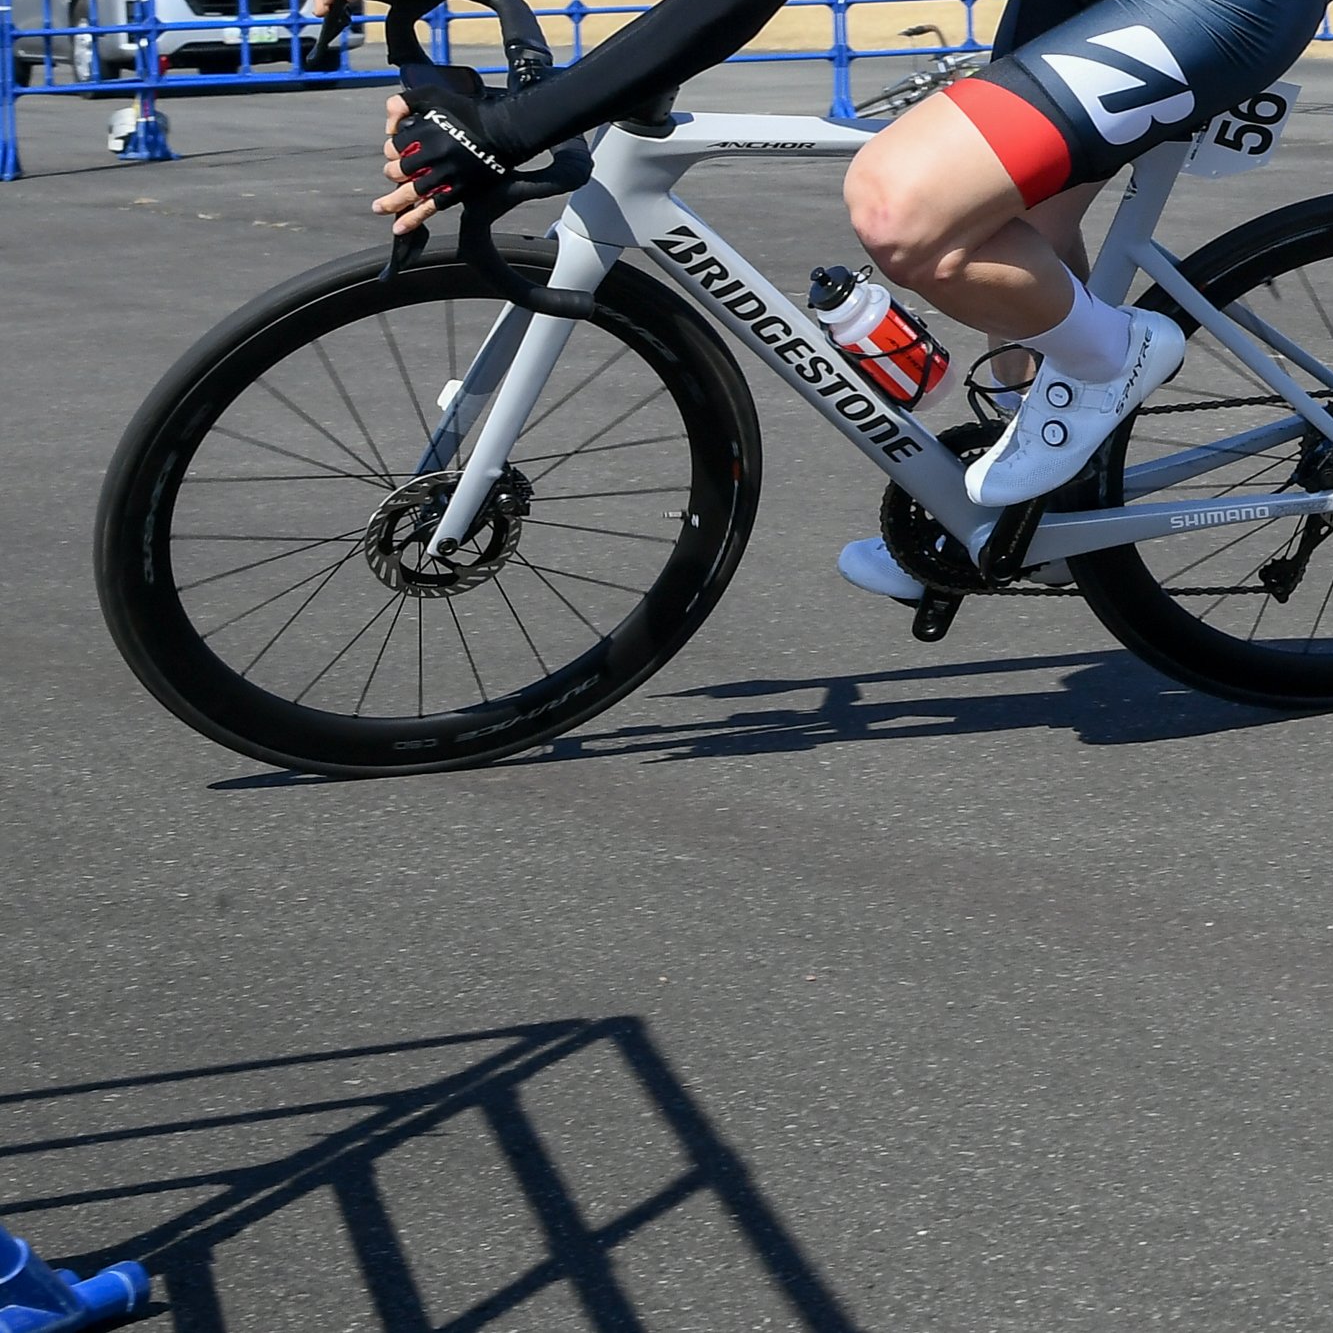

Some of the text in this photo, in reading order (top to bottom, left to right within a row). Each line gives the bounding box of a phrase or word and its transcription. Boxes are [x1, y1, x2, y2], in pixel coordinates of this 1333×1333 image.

[424, 109, 507, 175] Kabuto
[706, 141, 816, 151] ANCHOR
[1213, 92, 1287, 155] 56
[650, 225, 923, 464] BRIDGESTONE
[1169, 504, 1270, 530] SHIMANO
